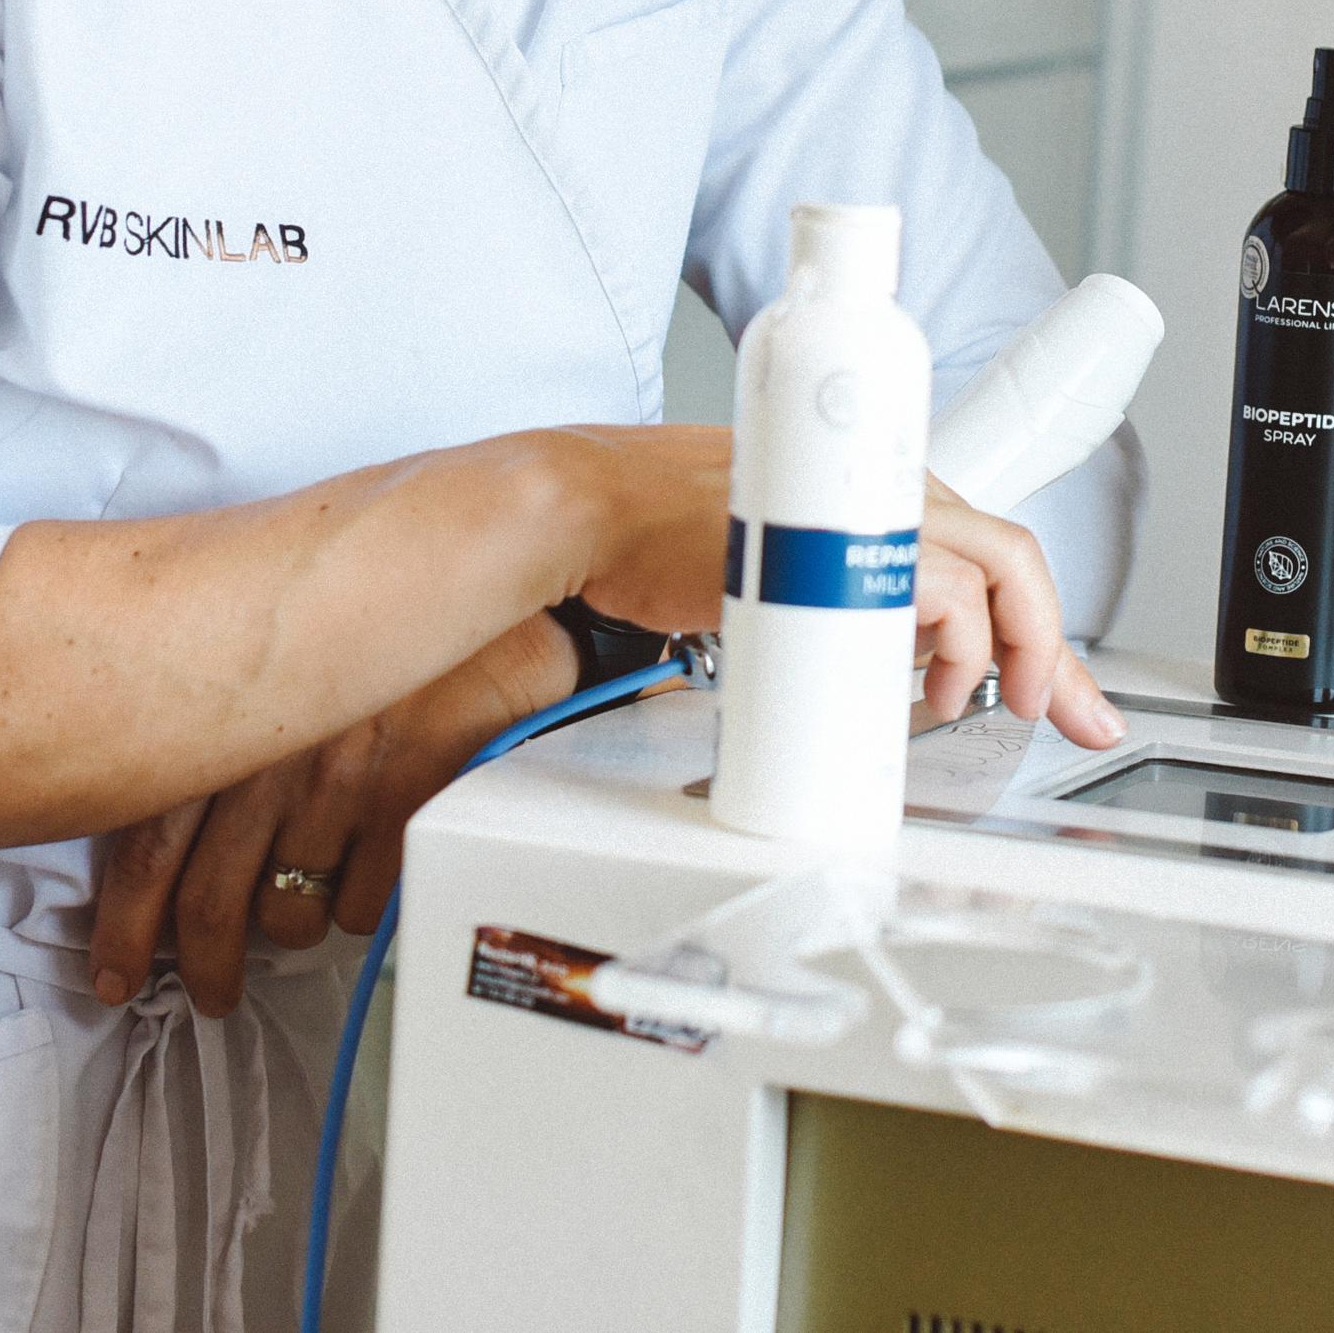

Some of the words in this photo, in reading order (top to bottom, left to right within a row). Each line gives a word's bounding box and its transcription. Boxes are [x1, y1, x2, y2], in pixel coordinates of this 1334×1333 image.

[36, 195, 117, 248] RVB
[1255, 314, 1321, 330] PROFESSIONAL
[1263, 429, 1317, 446] SPRAY
[863, 572, 911, 596] MILK
[1253, 635, 1299, 647] BIOPEPTIDE
